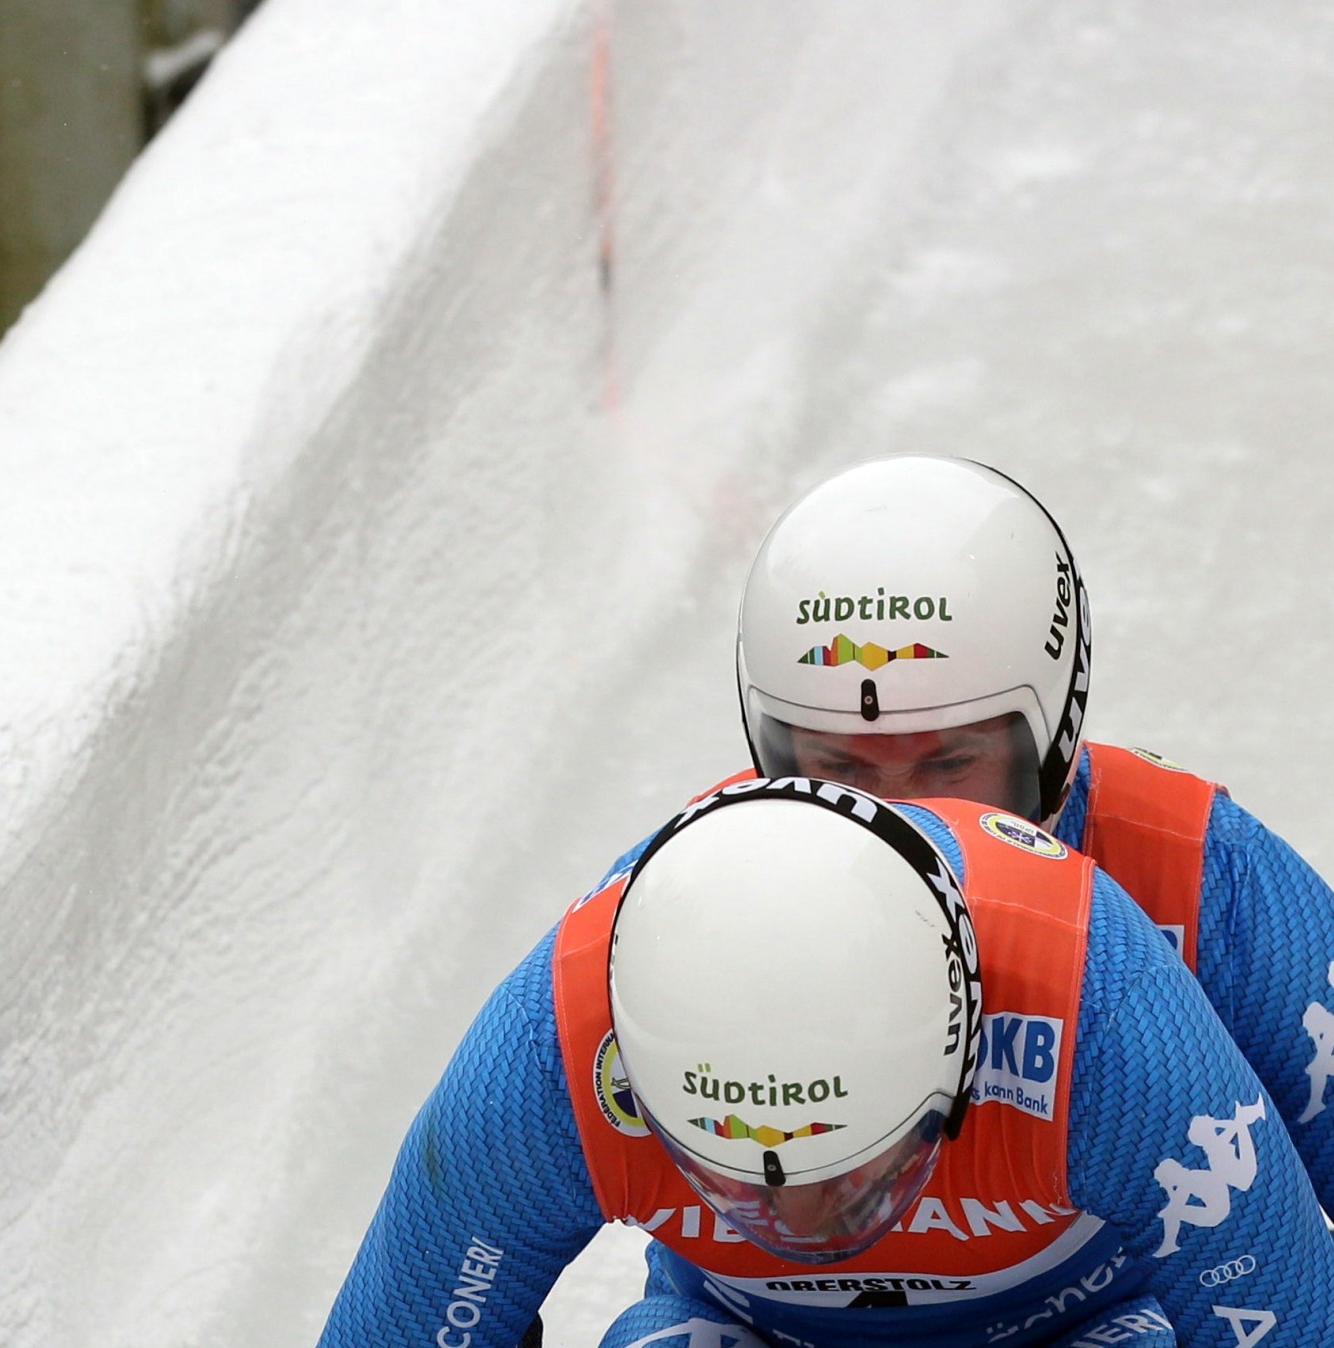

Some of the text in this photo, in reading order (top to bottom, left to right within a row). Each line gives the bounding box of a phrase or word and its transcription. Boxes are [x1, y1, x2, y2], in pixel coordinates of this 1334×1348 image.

[1044, 551, 1071, 661] uvex
[941, 933, 962, 1056] uvex
[984, 1081, 1014, 1101] kann
[1016, 1086, 1049, 1115] Bank
[765, 1278, 977, 1292] OBERSTOLZ
